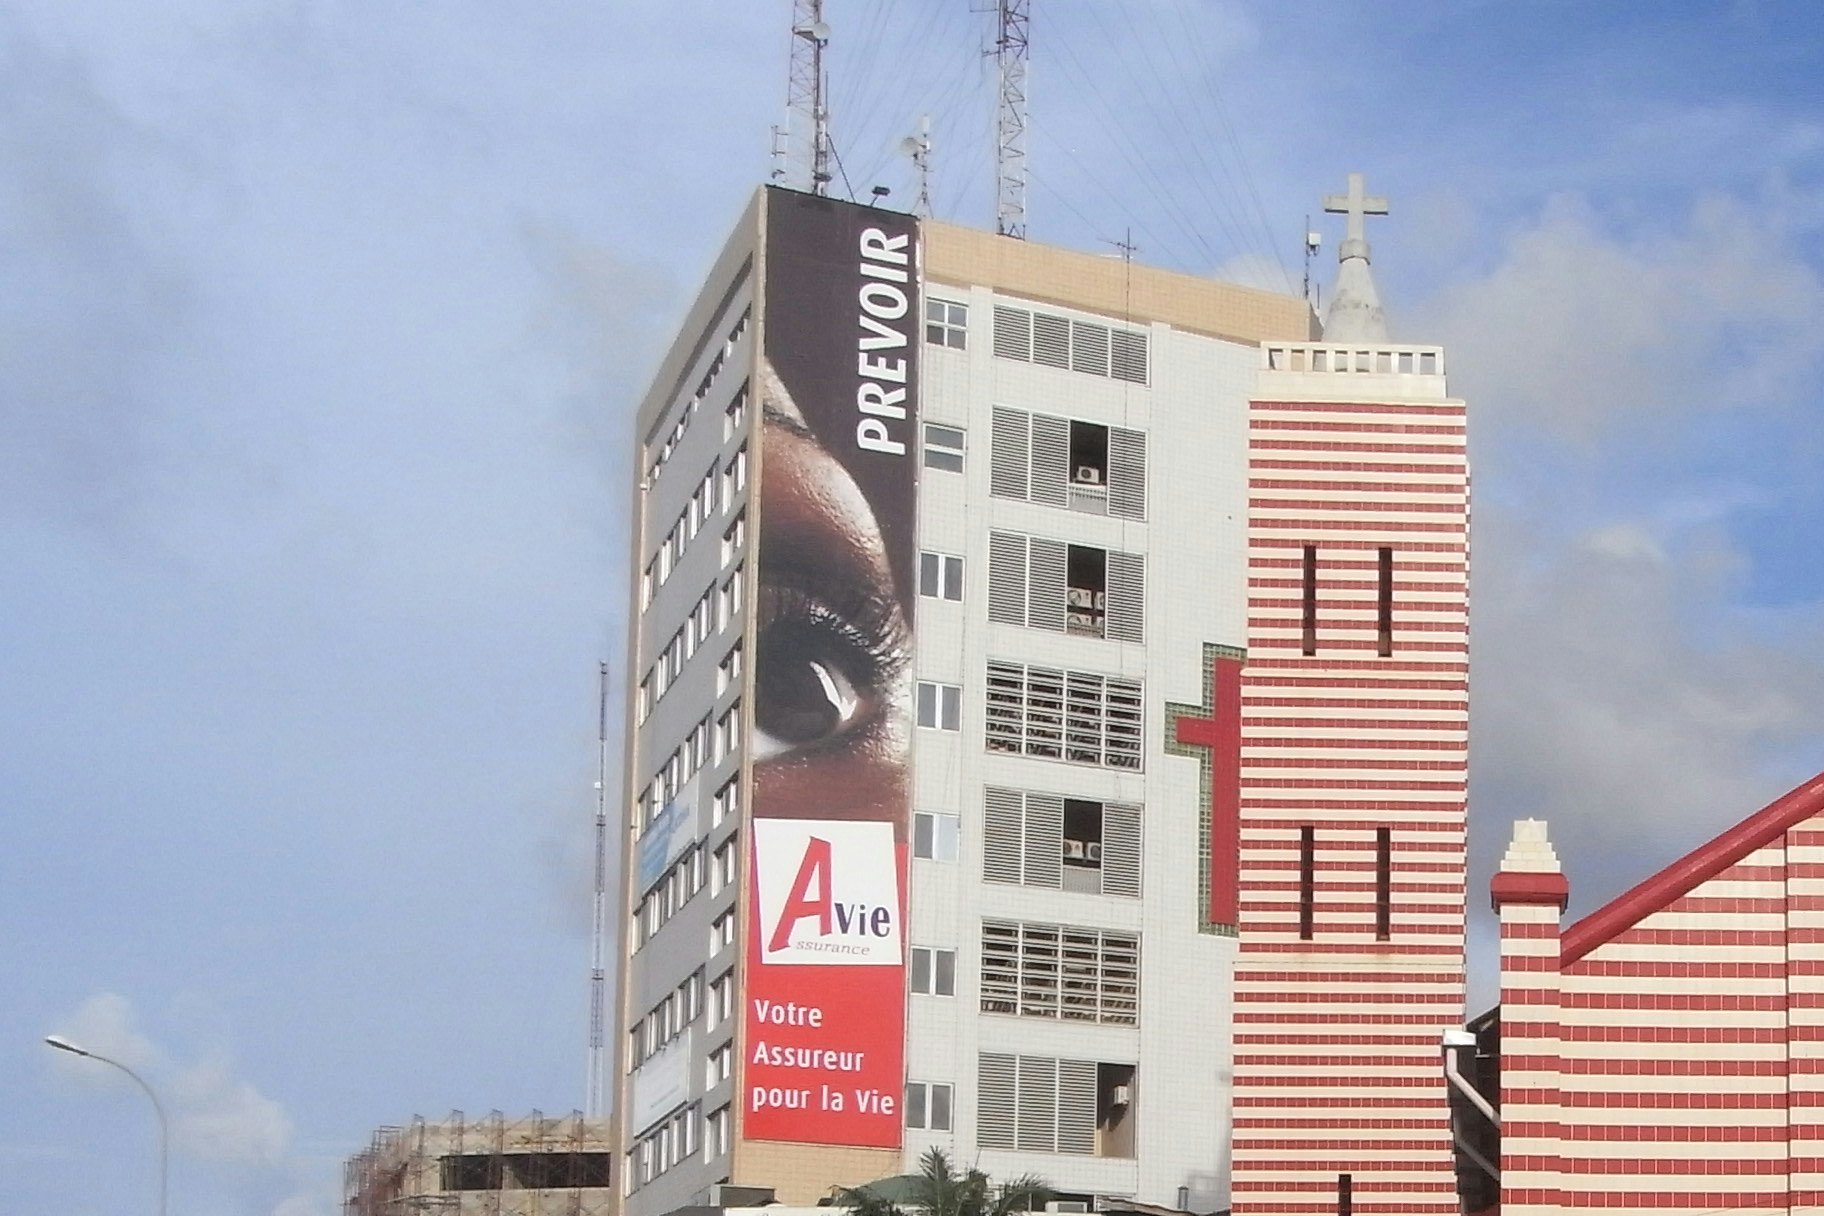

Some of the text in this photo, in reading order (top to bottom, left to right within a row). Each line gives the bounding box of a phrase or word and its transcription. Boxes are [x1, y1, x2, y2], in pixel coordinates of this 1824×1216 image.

[857, 227, 908, 455] PREVOIR
[754, 999, 823, 1028] Votre
[752, 1041, 864, 1072] Assureur
[752, 1084, 894, 1115] pour la Vie
